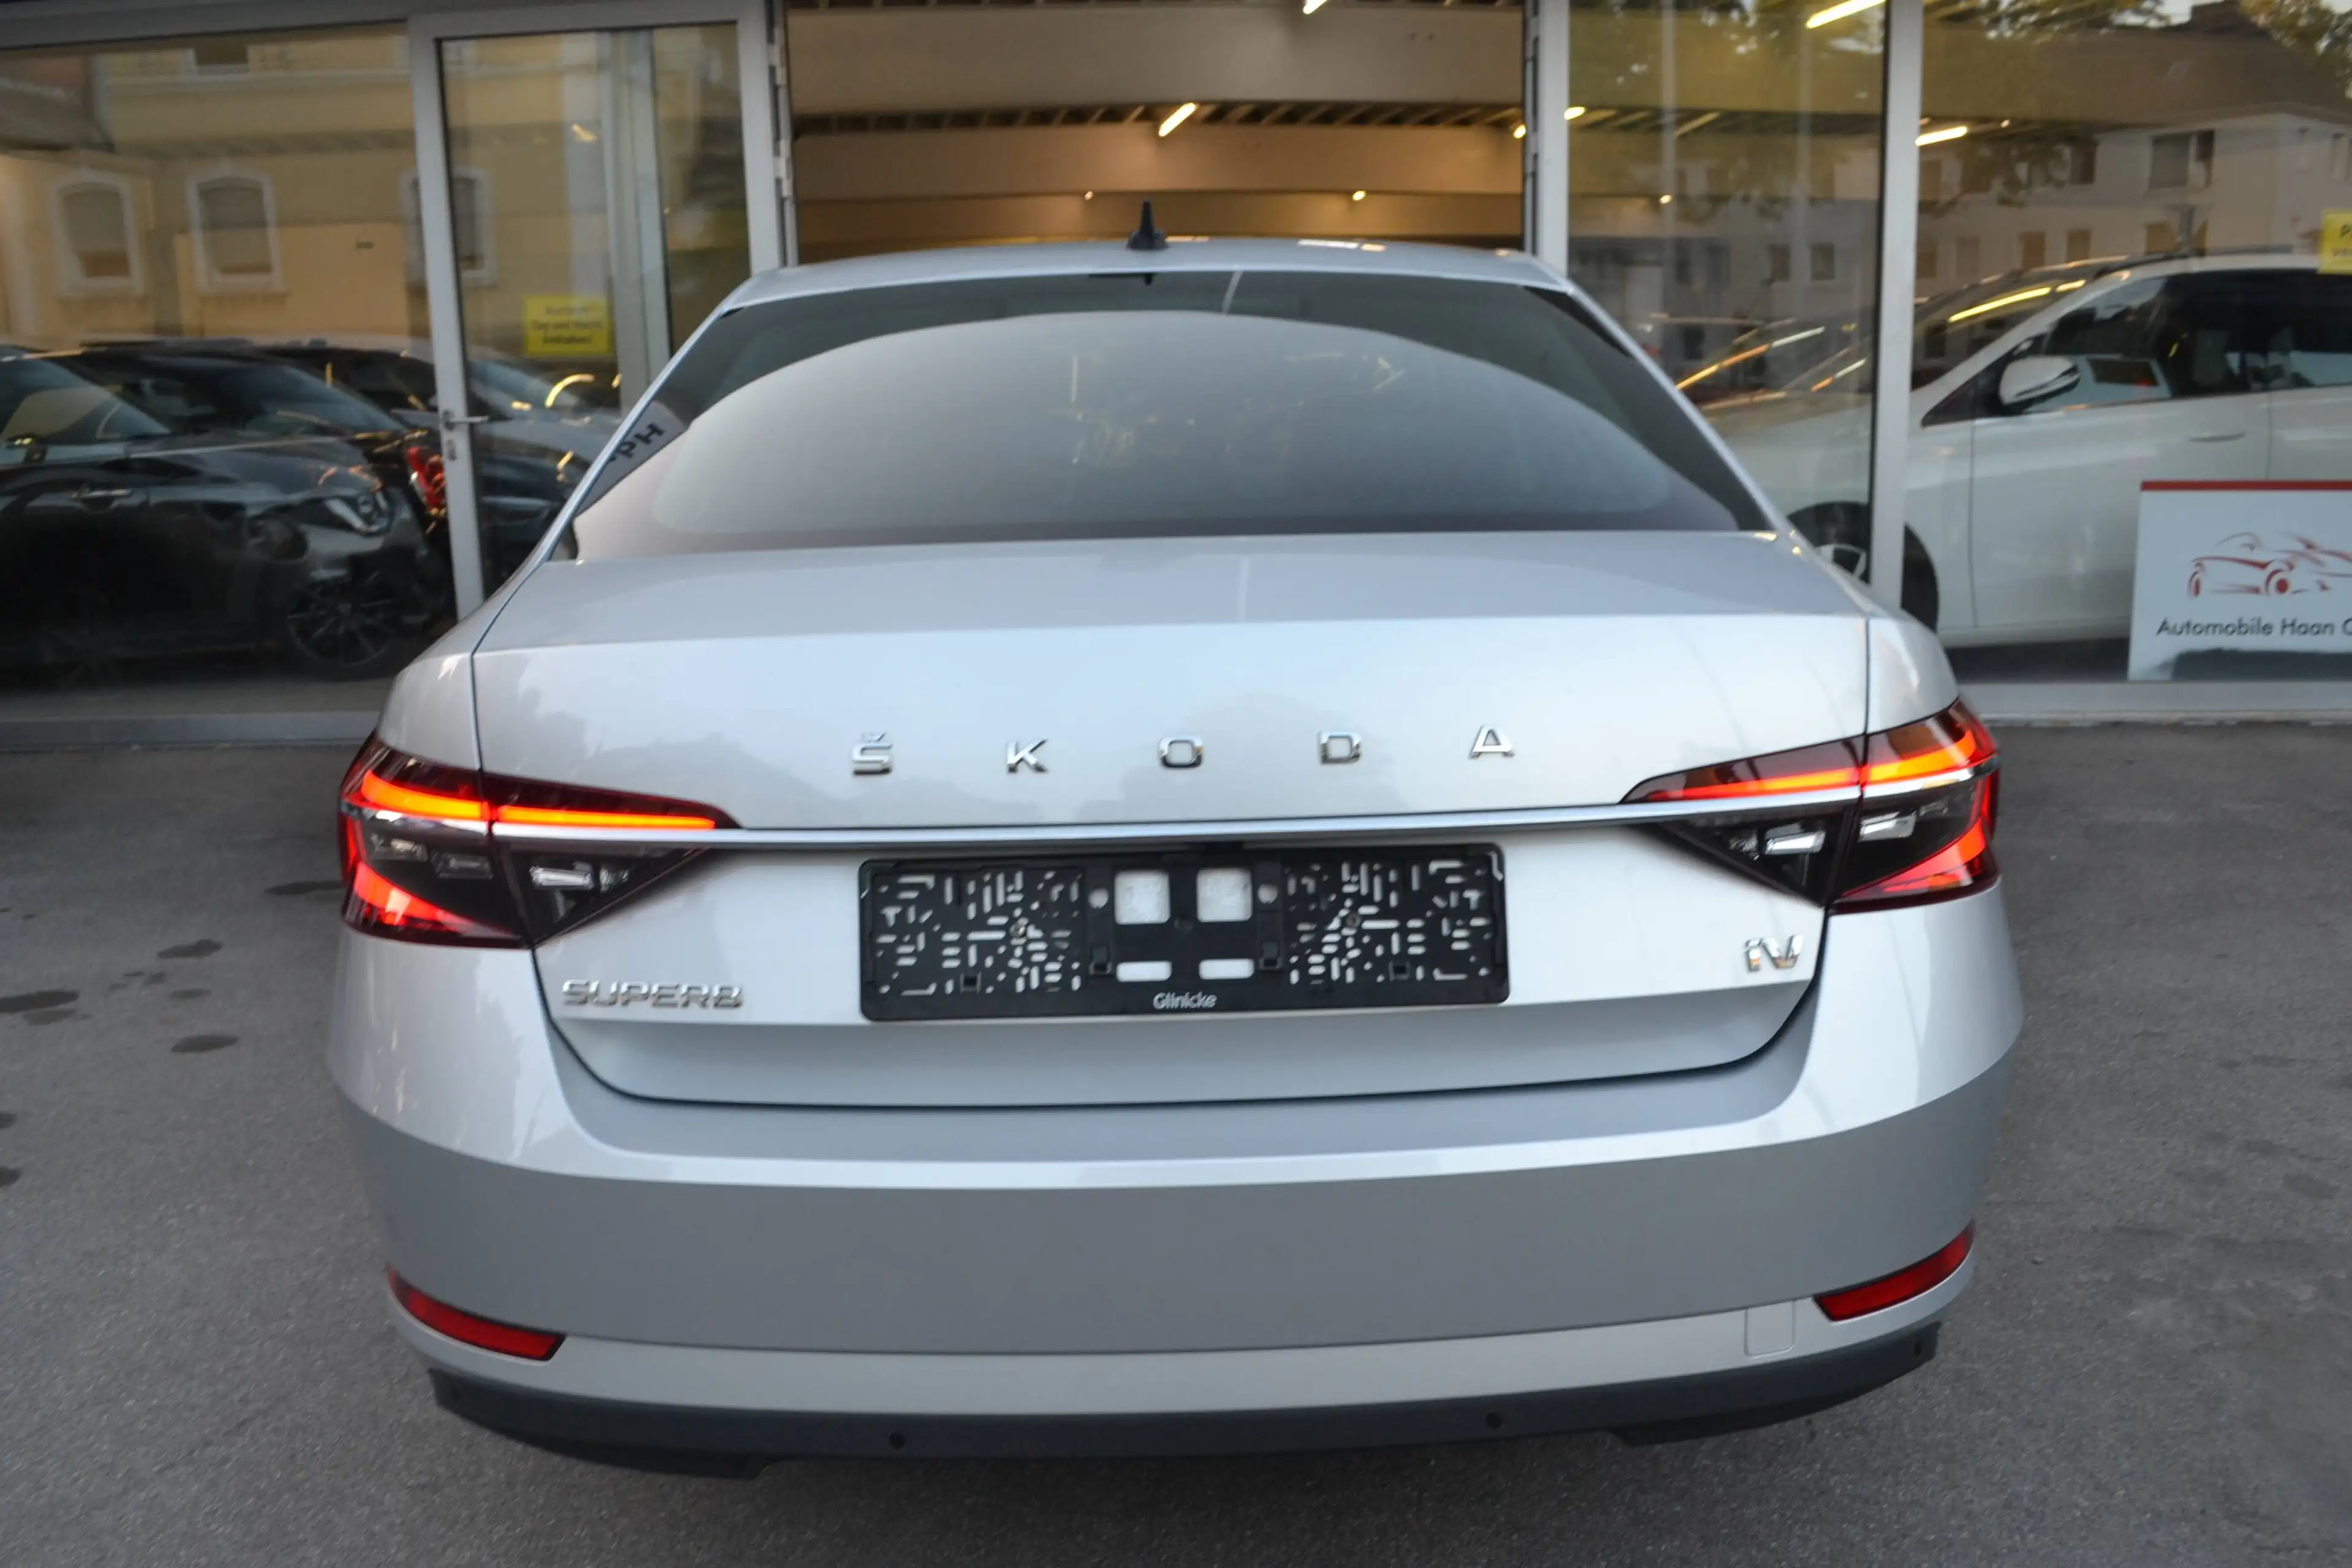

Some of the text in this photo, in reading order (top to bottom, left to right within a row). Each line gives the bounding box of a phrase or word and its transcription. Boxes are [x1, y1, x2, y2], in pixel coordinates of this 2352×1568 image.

[2156, 616, 2274, 636] Automobile
[2280, 617, 2335, 636] Haan
[562, 979, 744, 1009] SUPERB
[1152, 991, 1218, 1010] Glinicke
